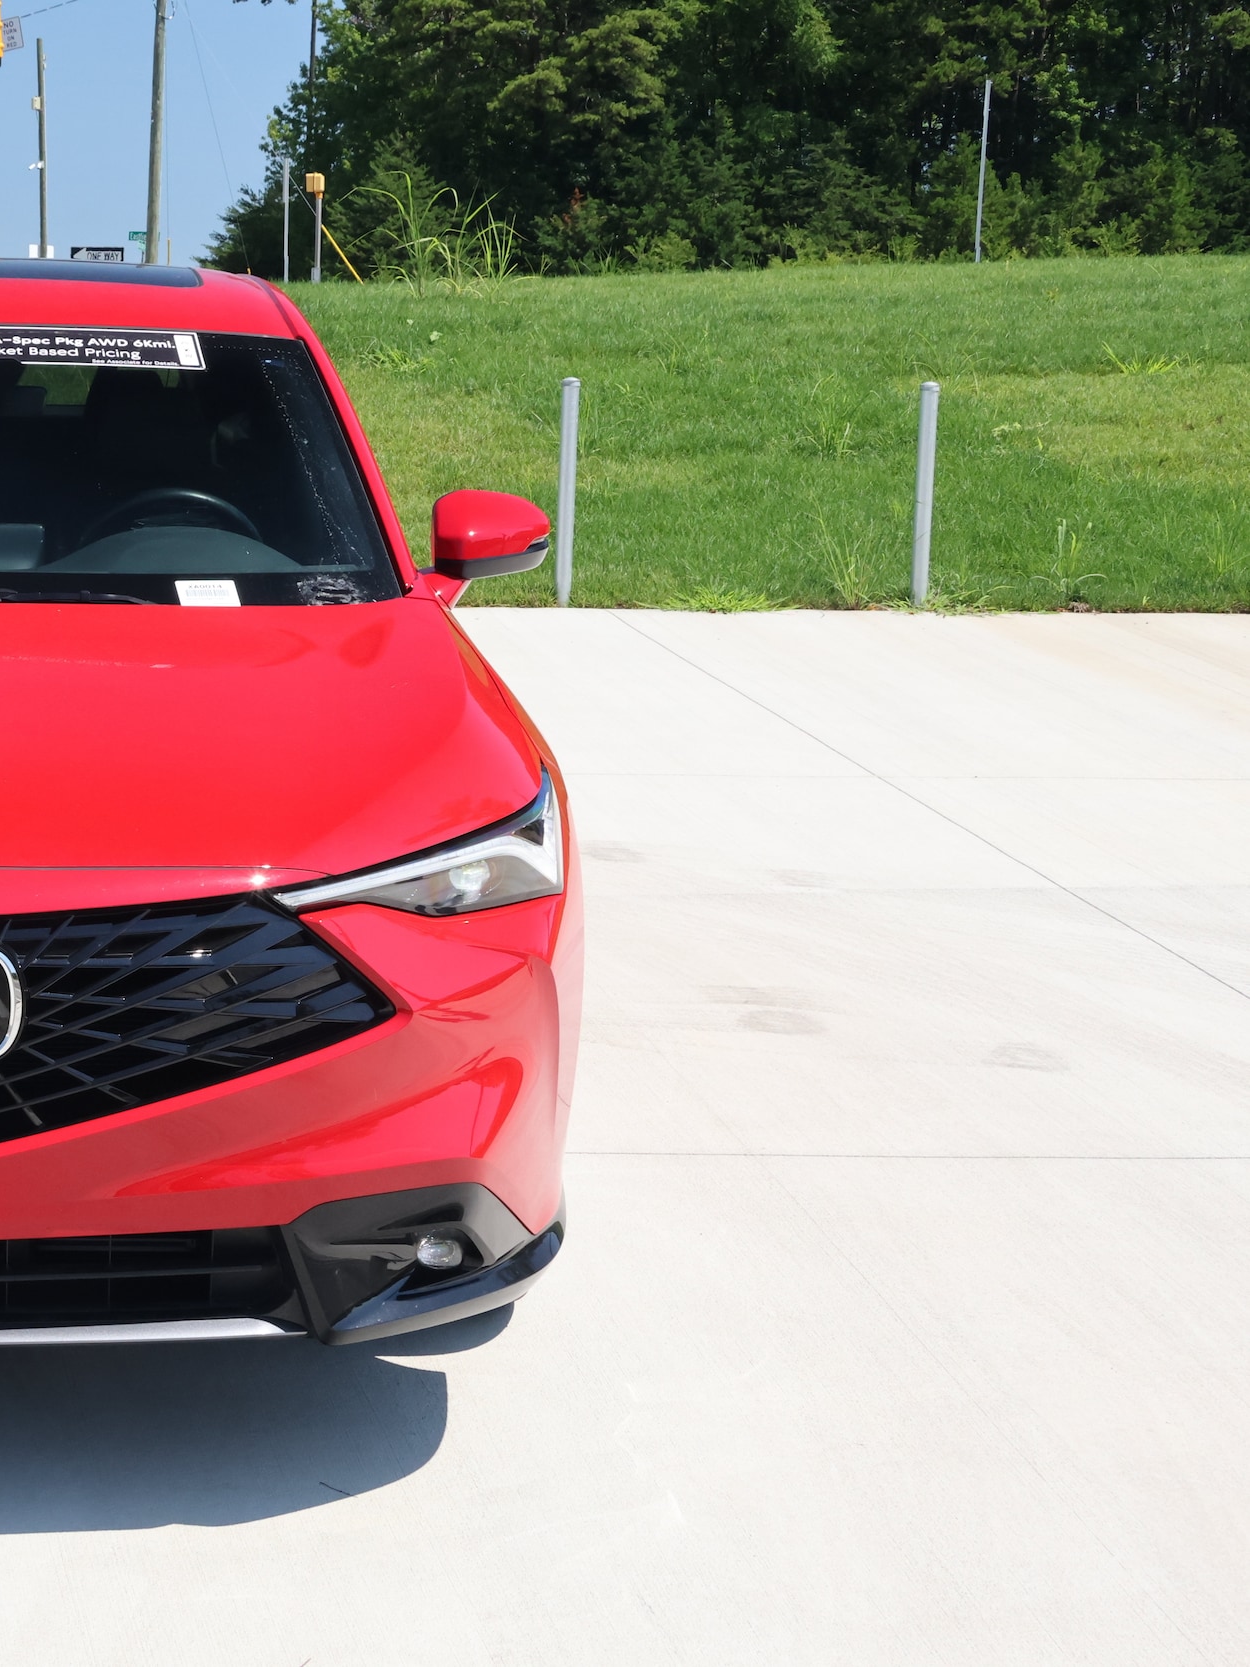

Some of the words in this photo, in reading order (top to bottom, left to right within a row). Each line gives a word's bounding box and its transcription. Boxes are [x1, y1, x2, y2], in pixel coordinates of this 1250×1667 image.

[3, 20, 14, 28] NO
[3, 28, 17, 36] TURN
[86, 252, 102, 260] ONE
[104, 251, 120, 261] WAY
[55, 337, 84, 347] Pkg
[87, 337, 129, 347] AWD
[29, 346, 79, 357] Based
[85, 348, 141, 360] Pricing
